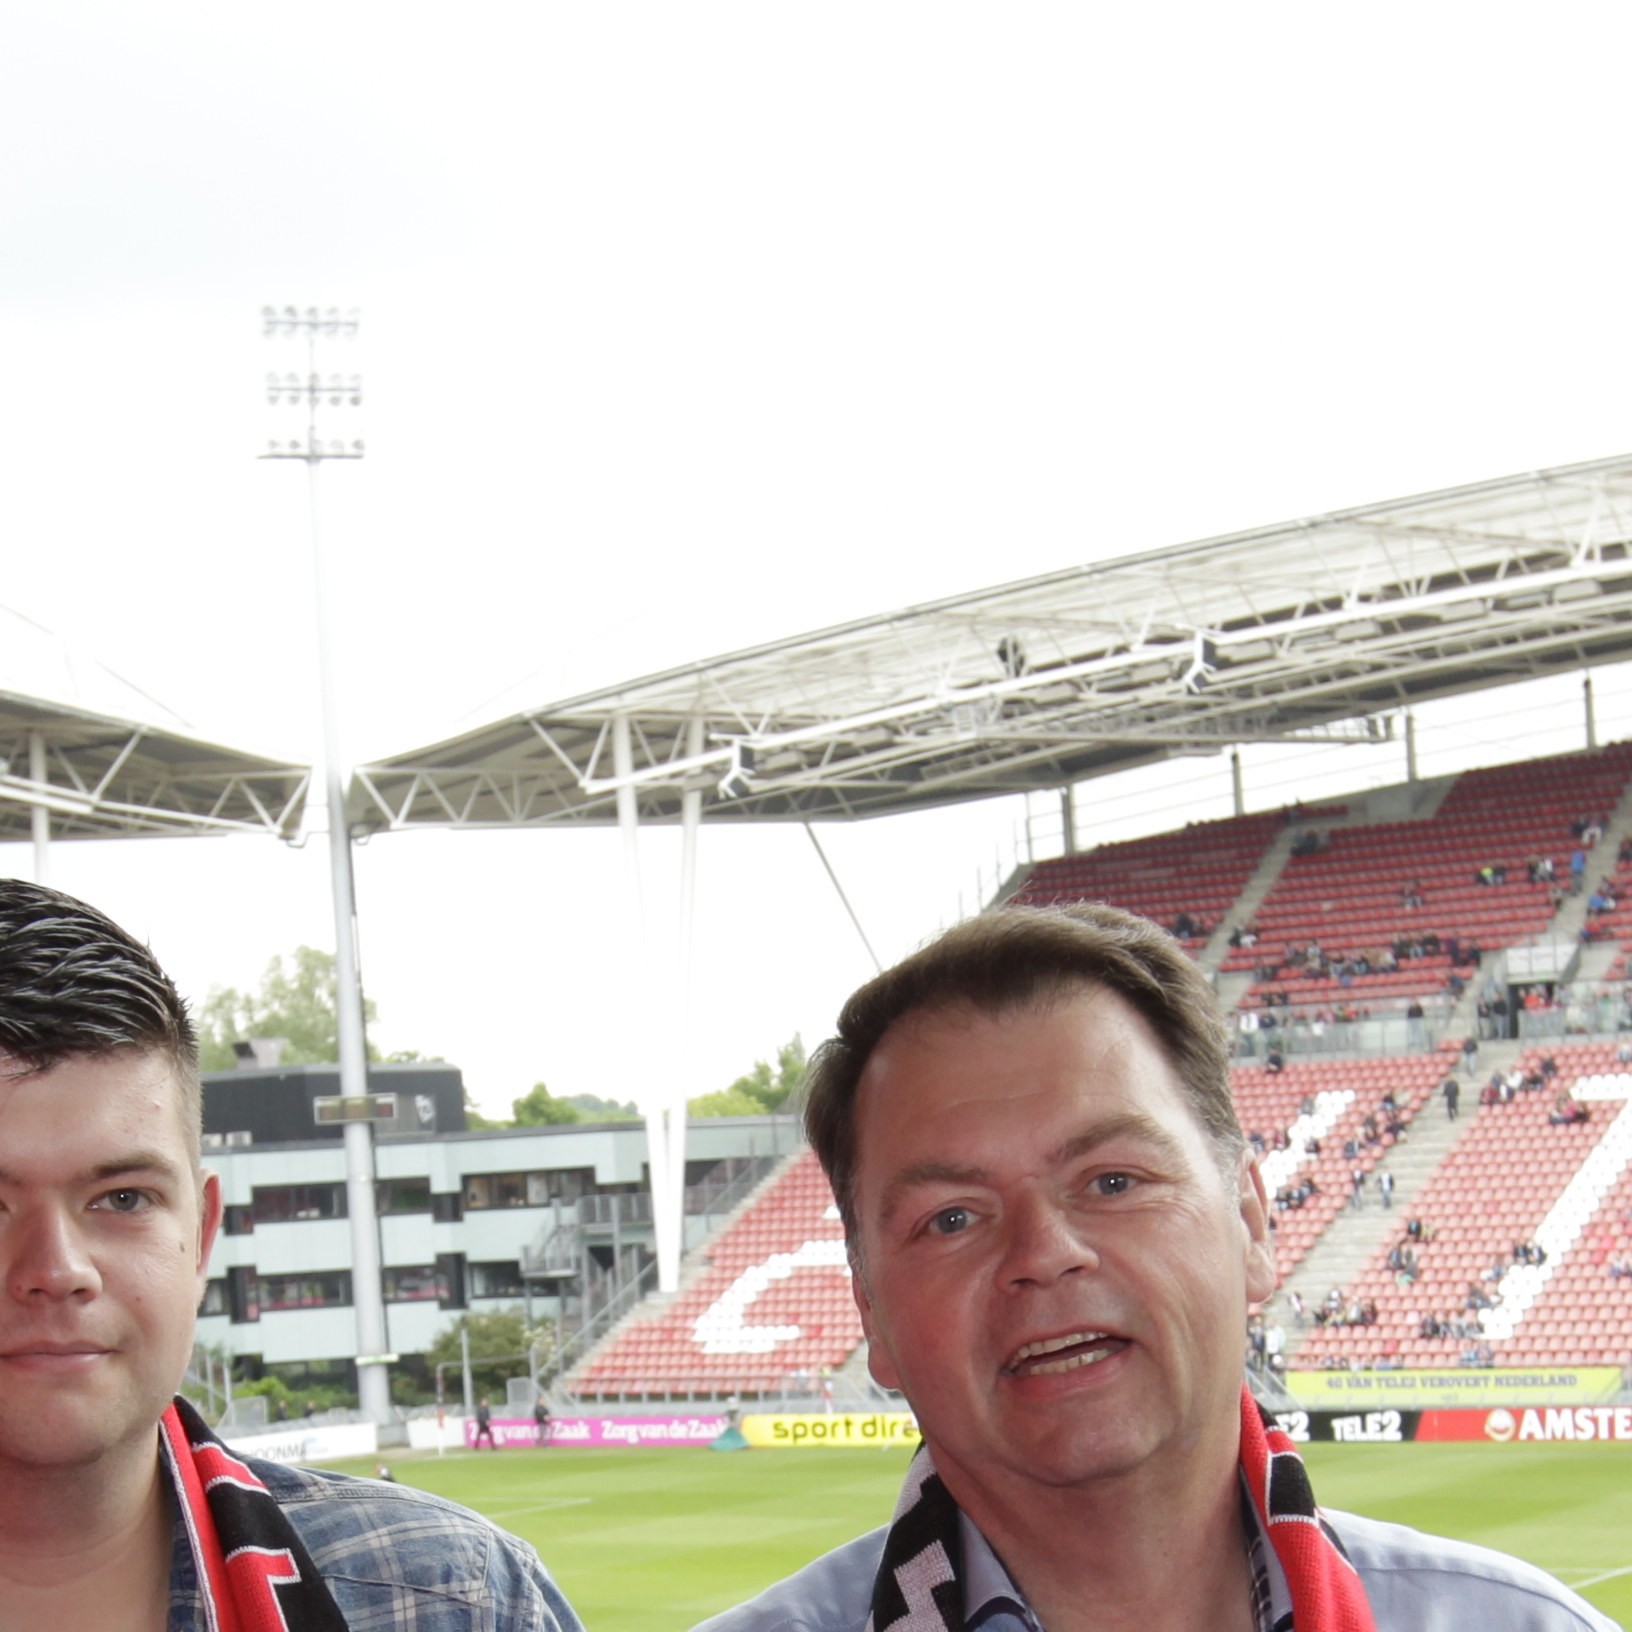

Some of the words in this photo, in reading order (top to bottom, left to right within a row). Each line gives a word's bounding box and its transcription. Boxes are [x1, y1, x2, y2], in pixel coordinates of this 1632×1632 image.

[1494, 1374, 1578, 1388] NEDERLAND
[551, 1420, 591, 1440] Zaak
[601, 1420, 639, 1444] Zorg
[639, 1423, 669, 1440] van
[669, 1419, 689, 1439] de
[772, 1417, 853, 1443] sport
[861, 1414, 920, 1439] dire
[1331, 1410, 1402, 1442] TELE2
